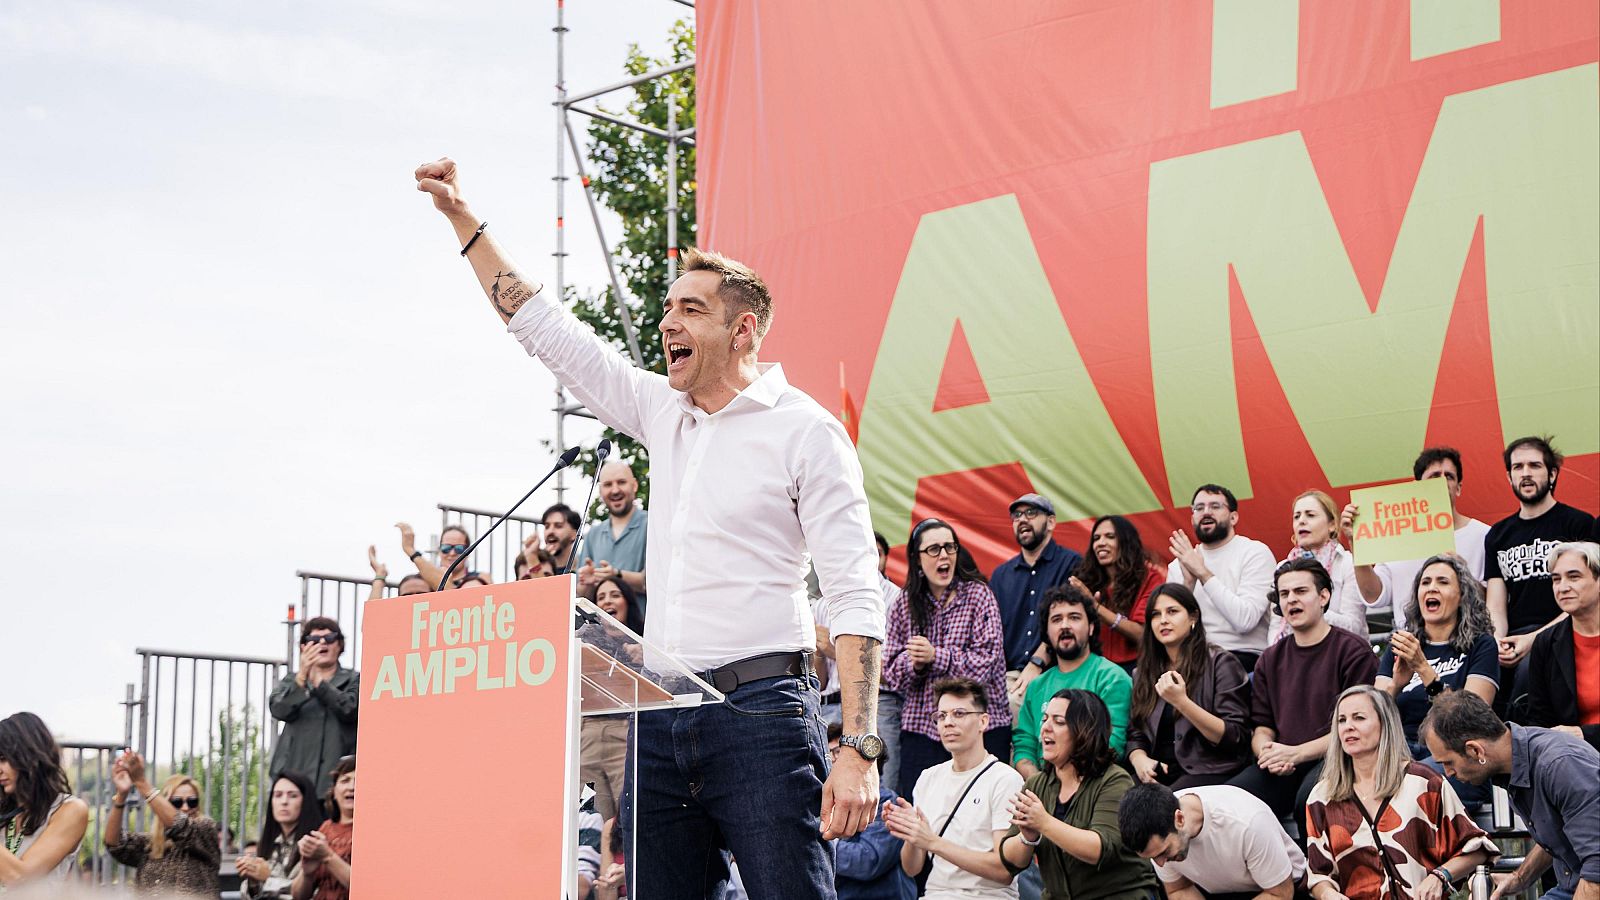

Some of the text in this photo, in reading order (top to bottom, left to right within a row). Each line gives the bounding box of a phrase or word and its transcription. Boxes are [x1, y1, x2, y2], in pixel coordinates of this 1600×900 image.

[500, 281, 522, 299] NOCERE
[509, 288, 523, 302] NON
[511, 290, 533, 309] PRIMUM
[1374, 497, 1429, 520] Frente
[1355, 512, 1454, 540] AMPLIO
[1510, 558, 1550, 581] CER
[411, 595, 516, 649] Frente
[370, 638, 557, 700] AMPLIO
